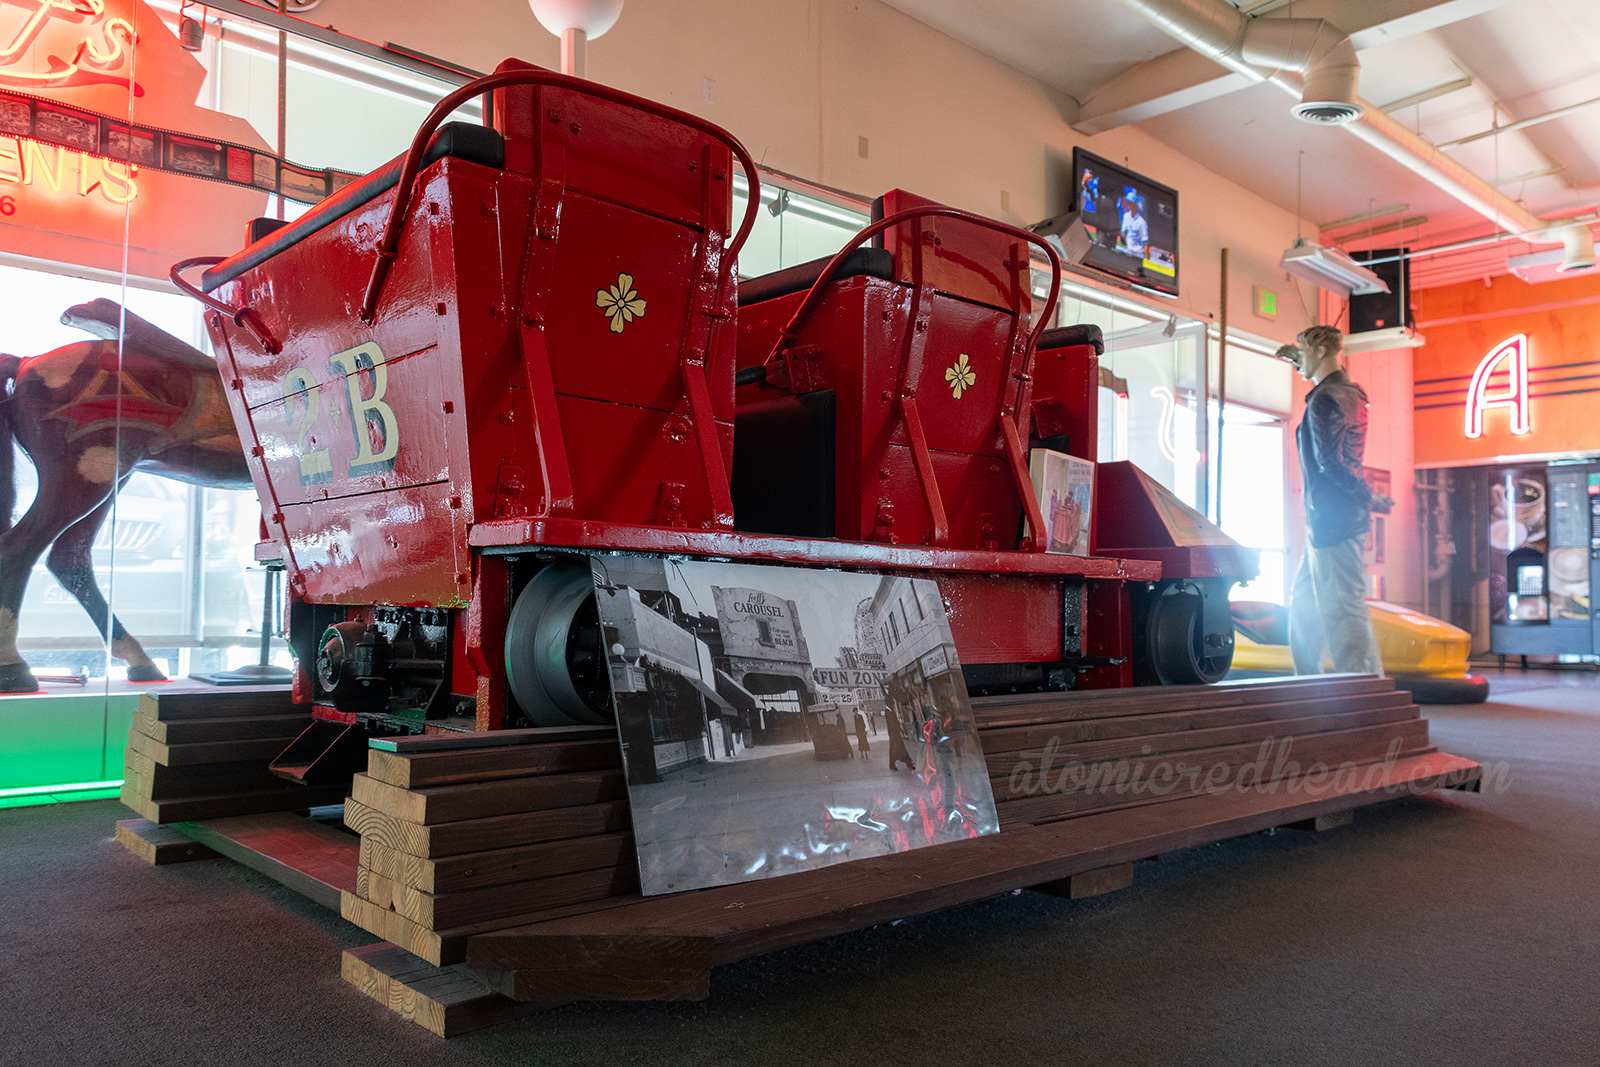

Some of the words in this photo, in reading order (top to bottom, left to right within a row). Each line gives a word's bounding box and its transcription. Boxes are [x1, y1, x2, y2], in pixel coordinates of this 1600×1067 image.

[1465, 333, 1530, 439] A
[733, 601, 785, 618] CAROUSEL
[819, 670, 849, 685] FUN
